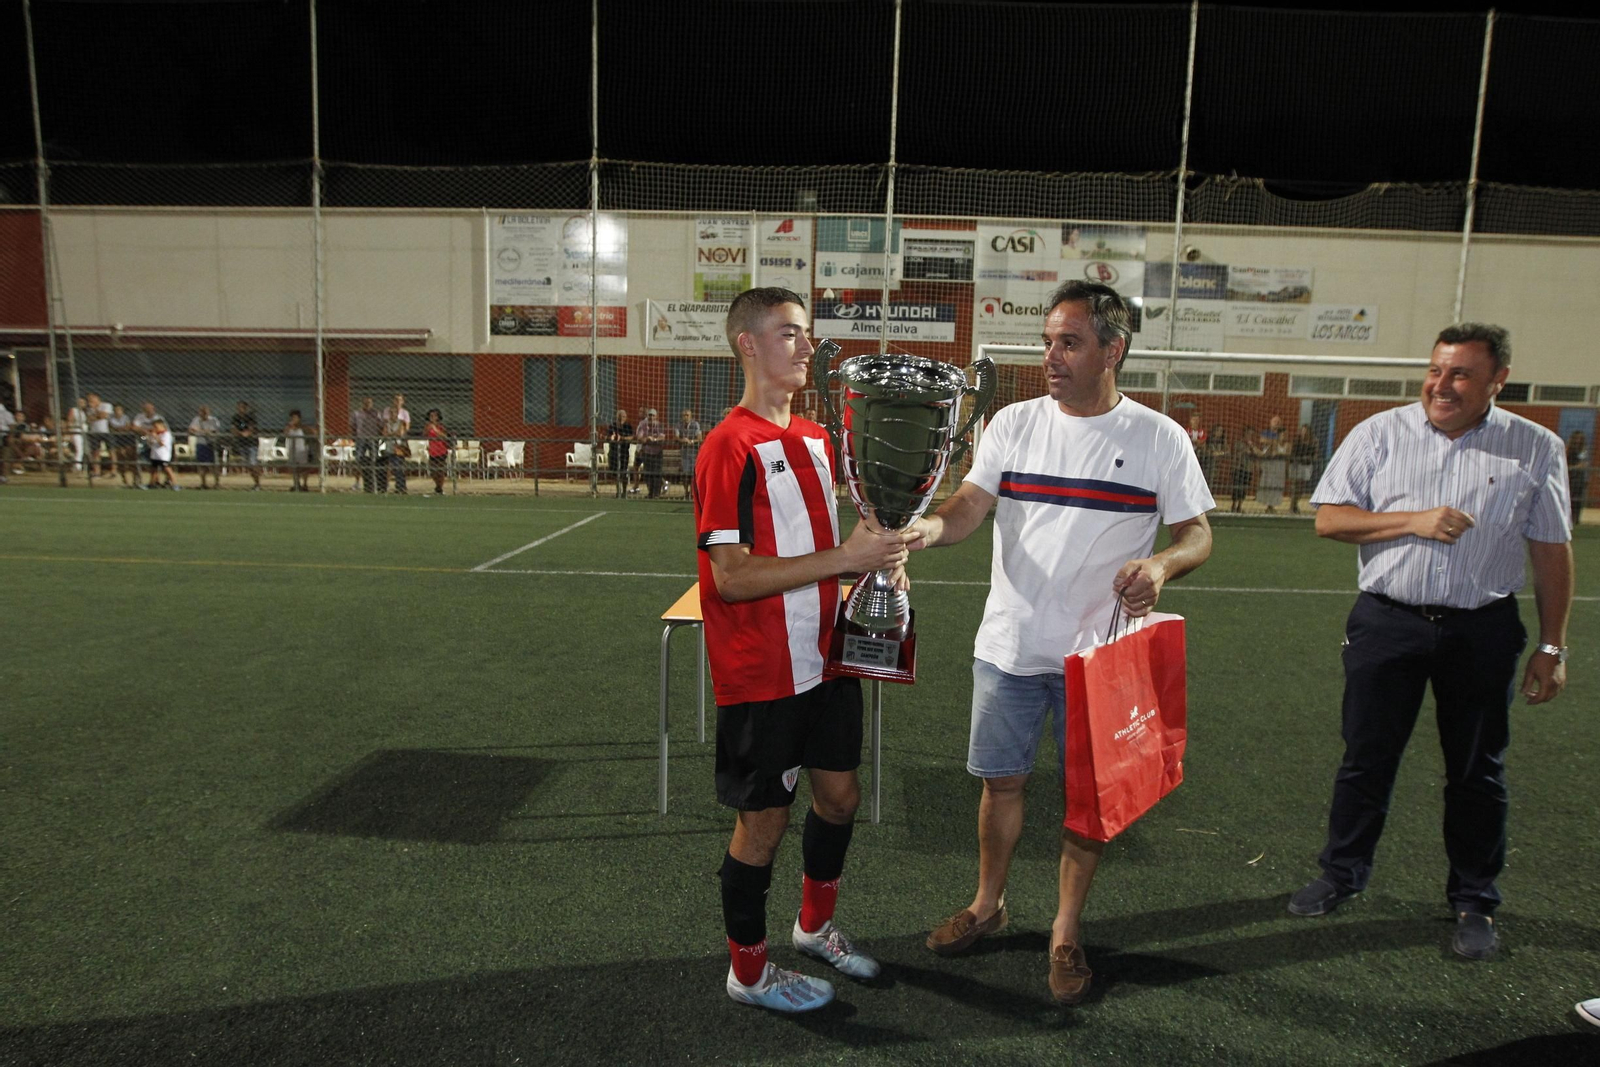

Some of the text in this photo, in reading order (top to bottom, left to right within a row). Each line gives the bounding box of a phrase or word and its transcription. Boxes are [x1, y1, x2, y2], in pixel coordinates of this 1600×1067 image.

[991, 236, 1035, 253] CASI
[697, 247, 747, 263] NOVI
[760, 257, 792, 267] asisa
[841, 265, 896, 279] cajamar
[667, 303, 677, 312] EL
[865, 305, 937, 319] HYUNDAI
[851, 322, 918, 335] Almerialva
[1312, 324, 1373, 341] LOS ARCOS
[1114, 718, 1141, 741] ATHLETIC
[1139, 709, 1156, 723] CLUB
